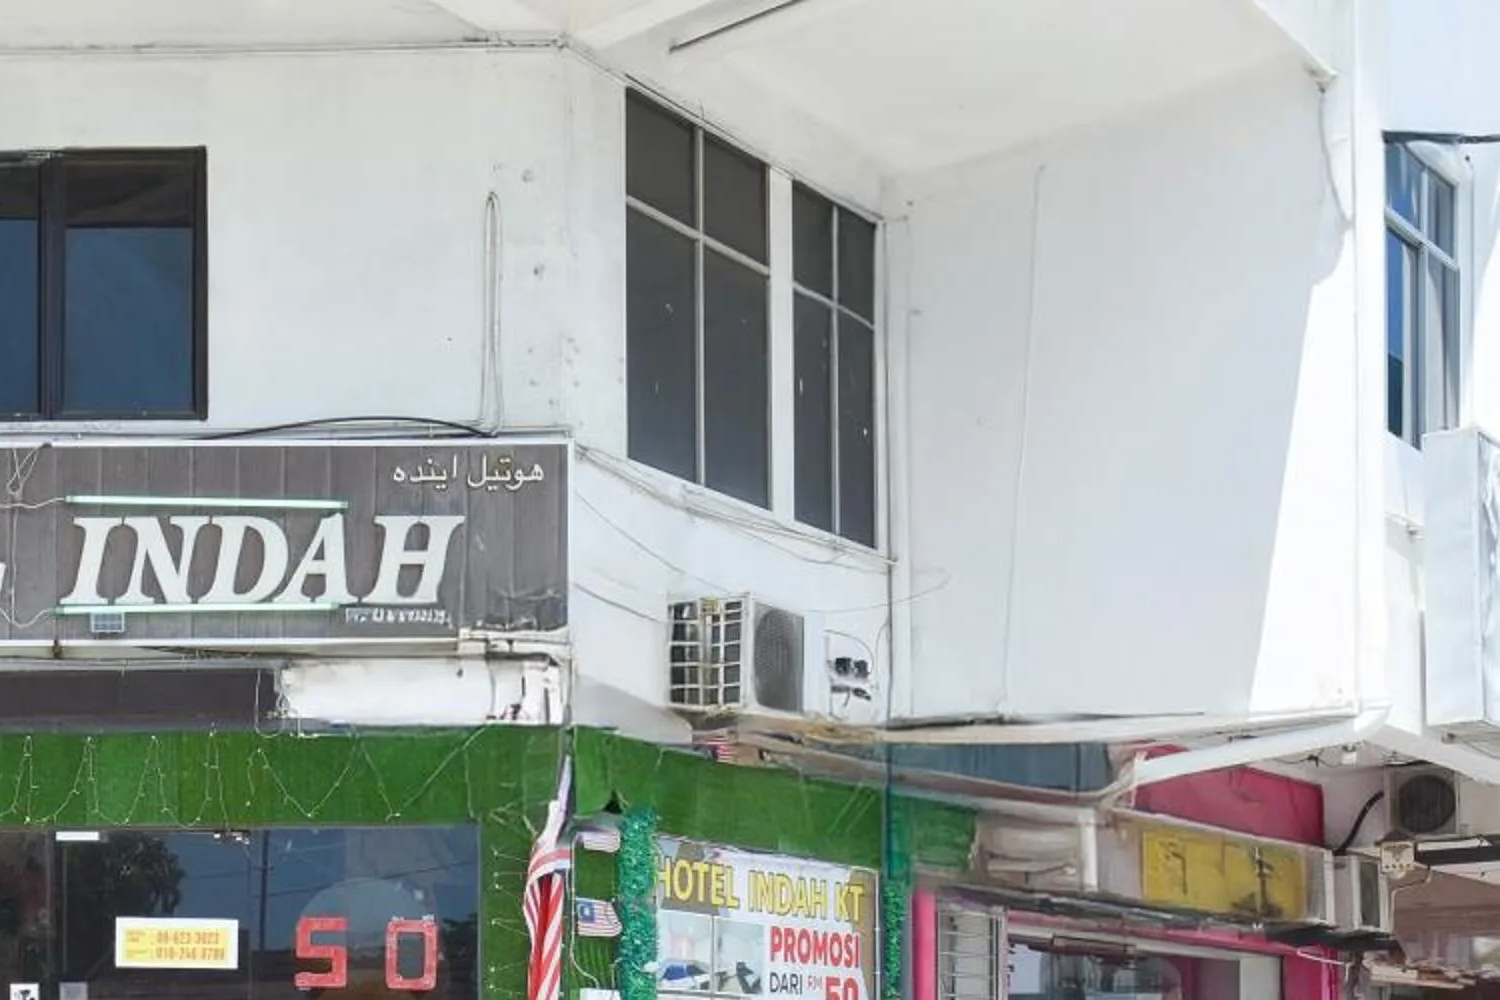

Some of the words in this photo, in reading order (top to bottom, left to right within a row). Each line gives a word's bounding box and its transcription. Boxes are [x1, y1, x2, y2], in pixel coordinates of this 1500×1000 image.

[59, 512, 467, 606] INDAH
[654, 857, 740, 909] HOTEL
[747, 868, 829, 920] INDAH
[835, 880, 865, 922] KT
[769, 925, 860, 969] PROMOSI
[769, 971, 803, 995] DARI
